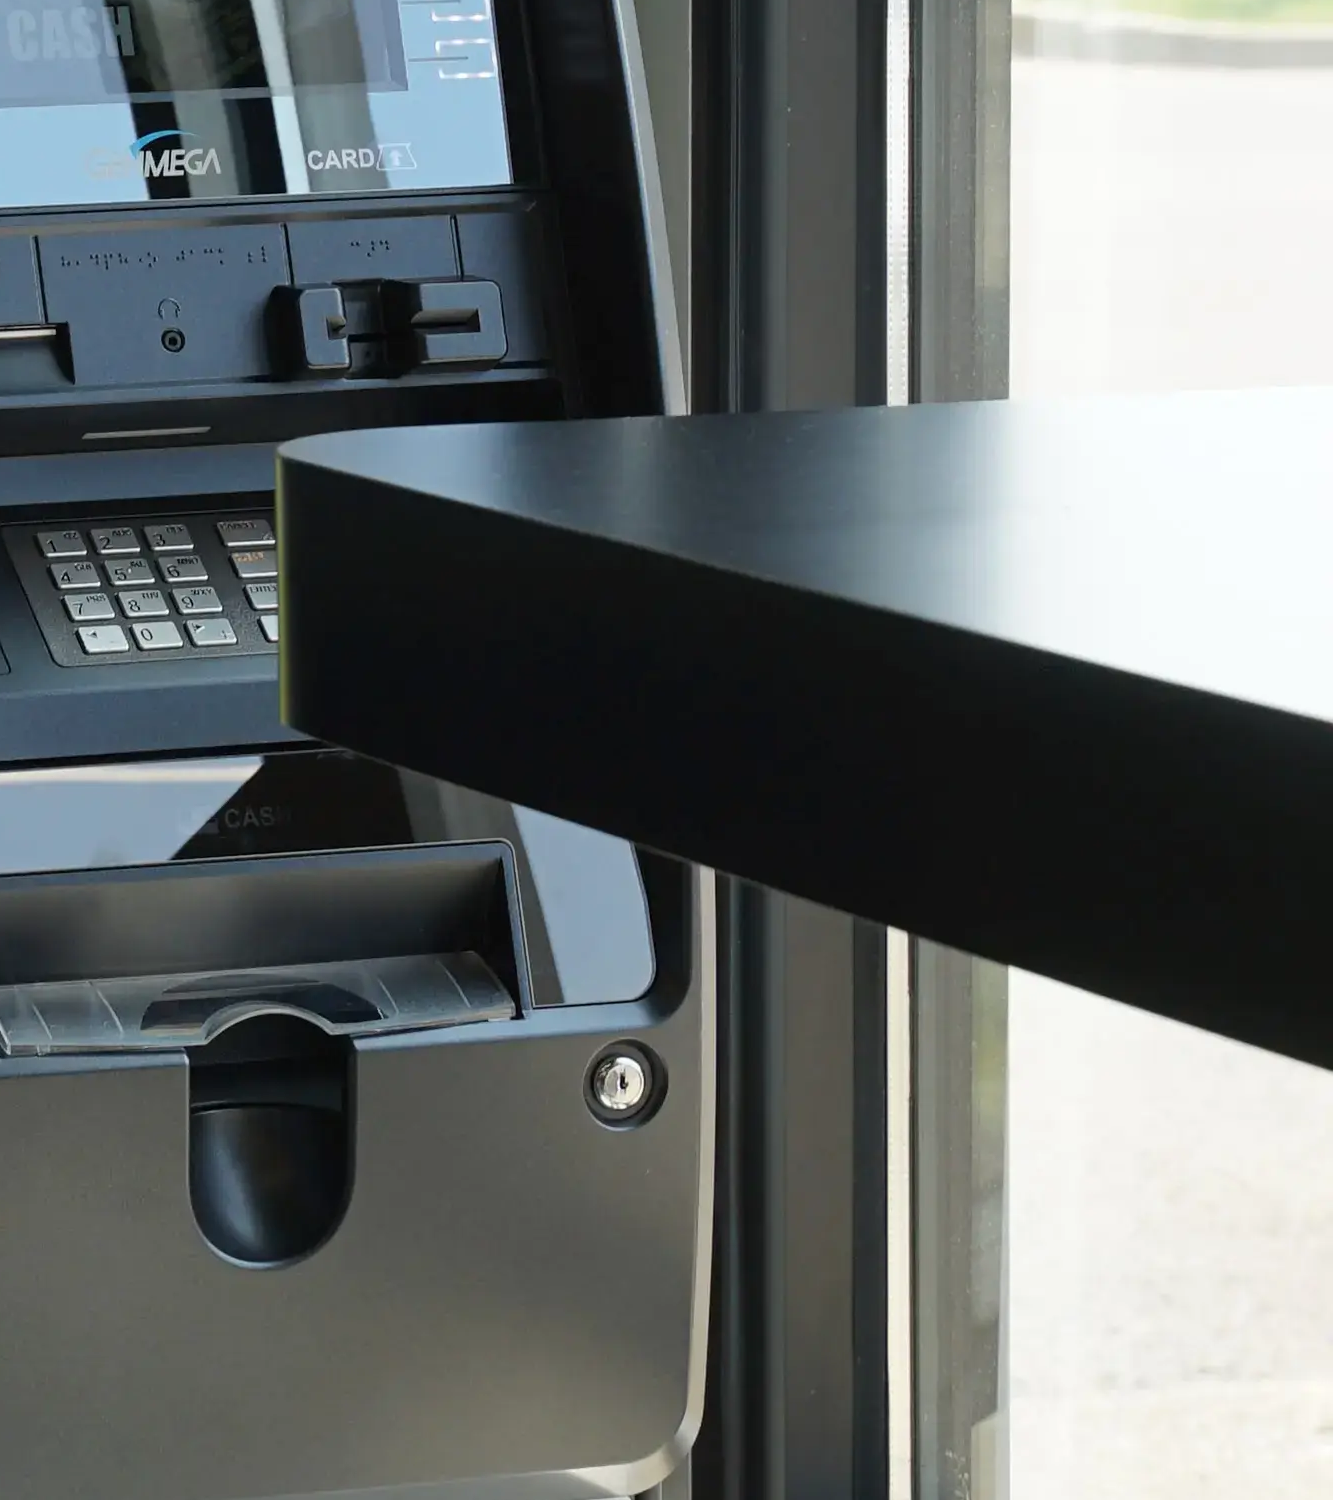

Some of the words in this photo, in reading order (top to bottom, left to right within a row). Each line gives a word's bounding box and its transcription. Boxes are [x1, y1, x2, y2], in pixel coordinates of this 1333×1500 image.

[6, 5, 135, 62] CASH
[308, 148, 374, 170] CARD
[46, 539, 57, 552] 1
[99, 536, 112, 549] 2
[153, 533, 166, 547] 3
[61, 571, 72, 583] 4
[115, 568, 127, 581] 5
[166, 565, 180, 578] 6
[72, 602, 84, 615] 7
[128, 599, 141, 612] 8
[181, 595, 194, 609] 9
[140, 627, 153, 641] 0
